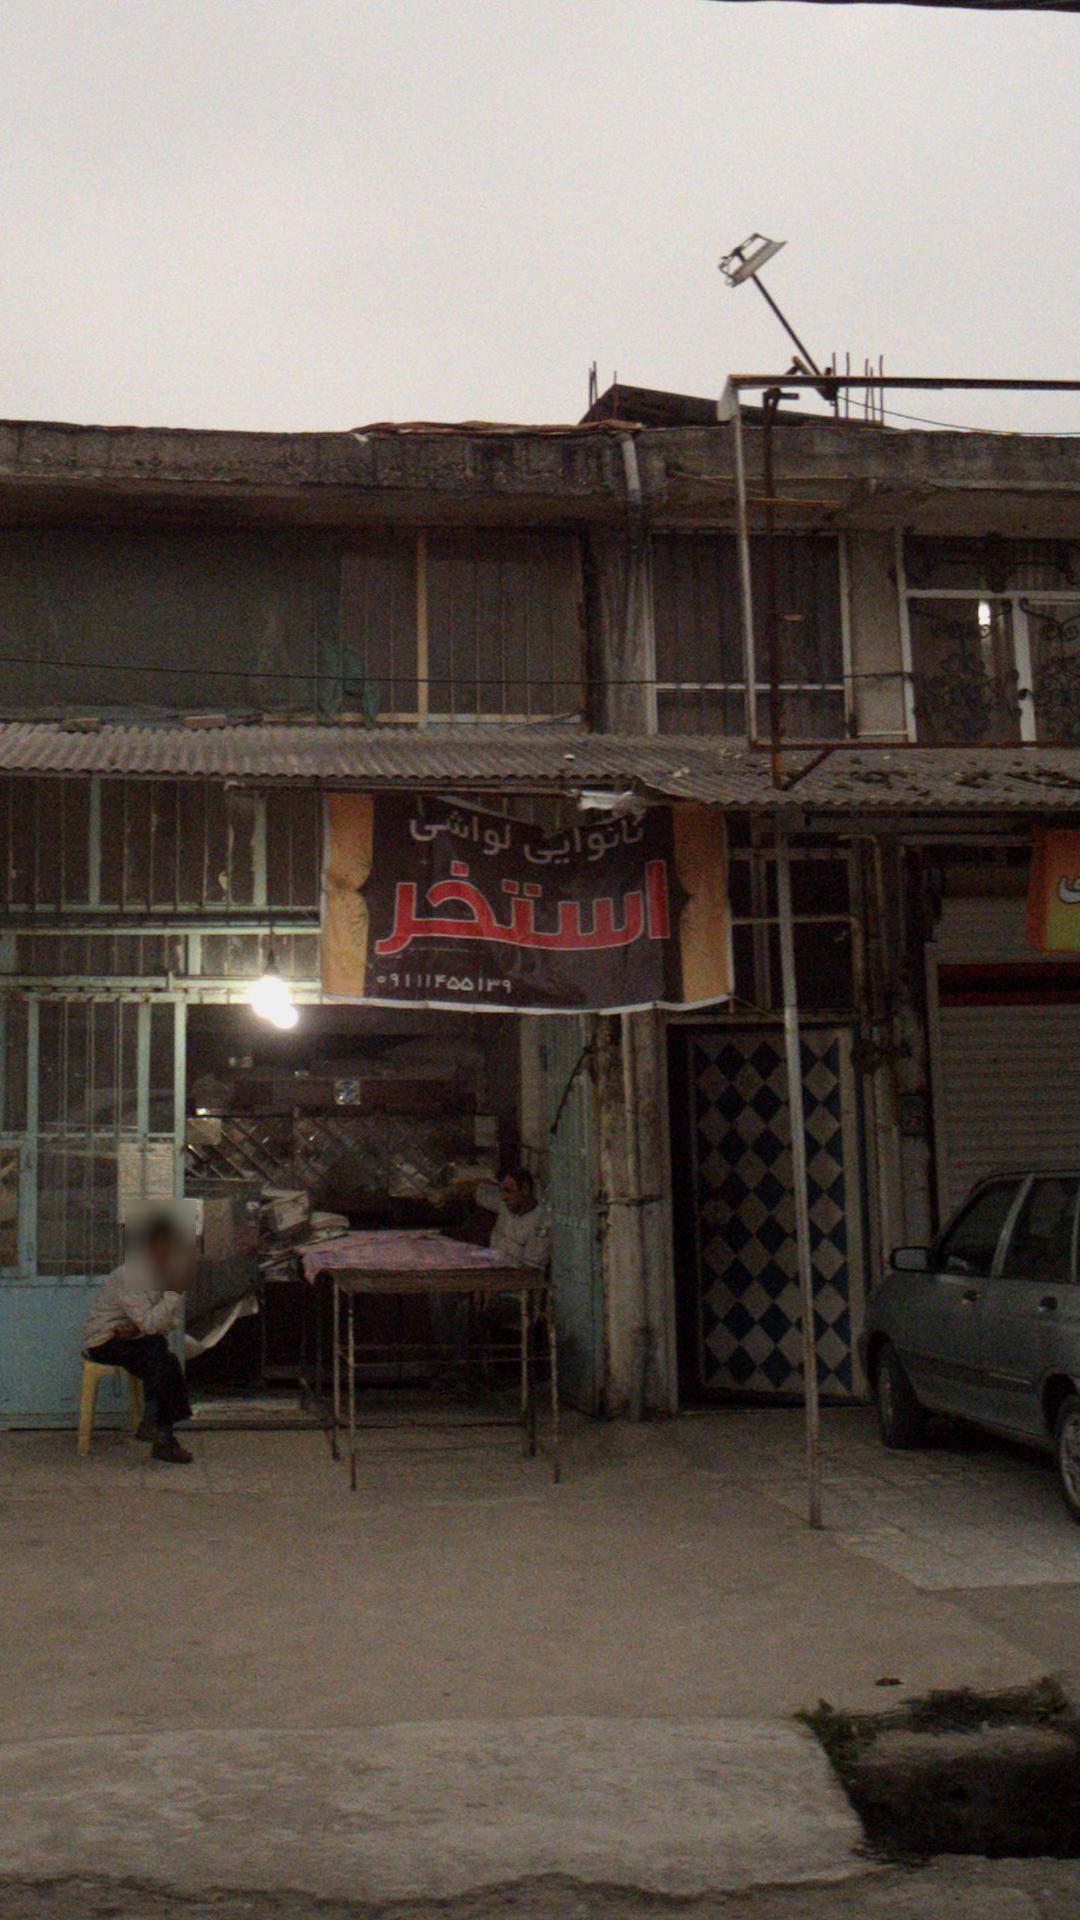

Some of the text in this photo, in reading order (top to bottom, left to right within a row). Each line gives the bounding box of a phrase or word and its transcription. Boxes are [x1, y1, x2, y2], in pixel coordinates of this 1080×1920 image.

[409, 809, 644, 864] نانوایی لواشی
[374, 860, 671, 955] استخر
